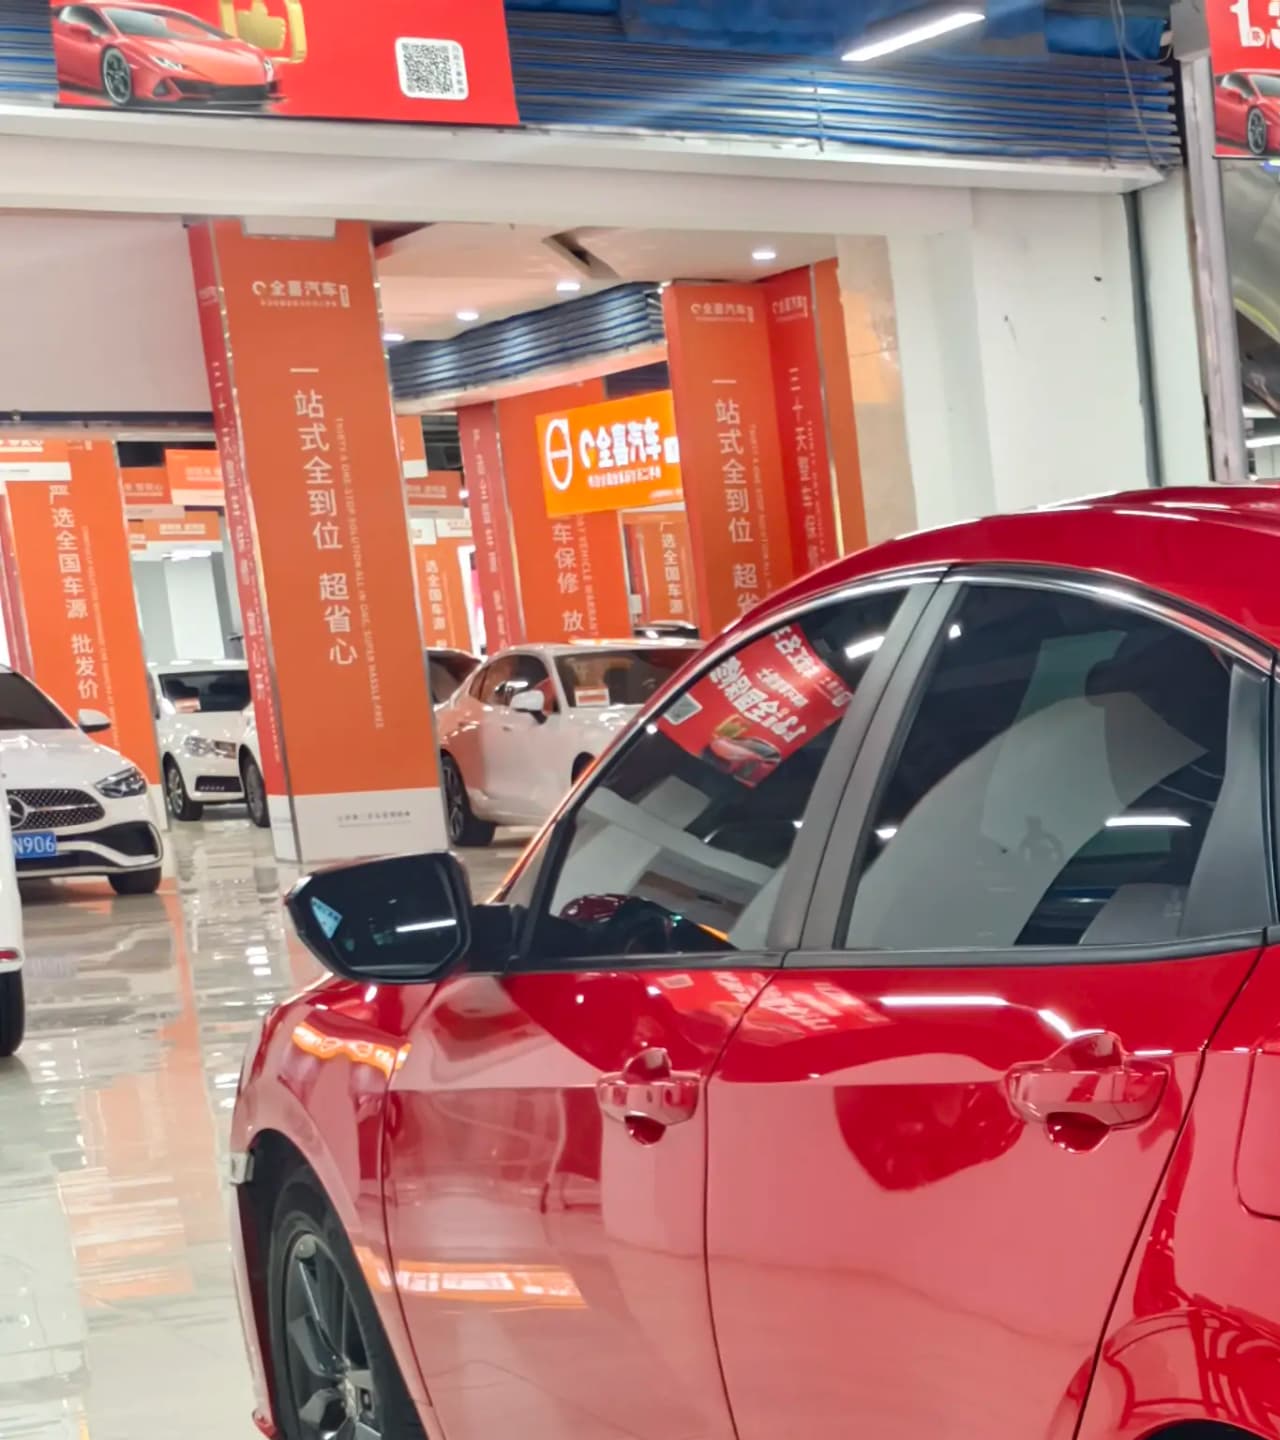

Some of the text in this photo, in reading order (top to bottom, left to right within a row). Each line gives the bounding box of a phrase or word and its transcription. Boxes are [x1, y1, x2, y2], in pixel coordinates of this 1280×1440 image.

[289, 366, 359, 668] 一站式全到位 超省心
[711, 379, 754, 544] 一站式全到位
[49, 484, 89, 620] 严选全国车源
[70, 633, 100, 700] 批发价
